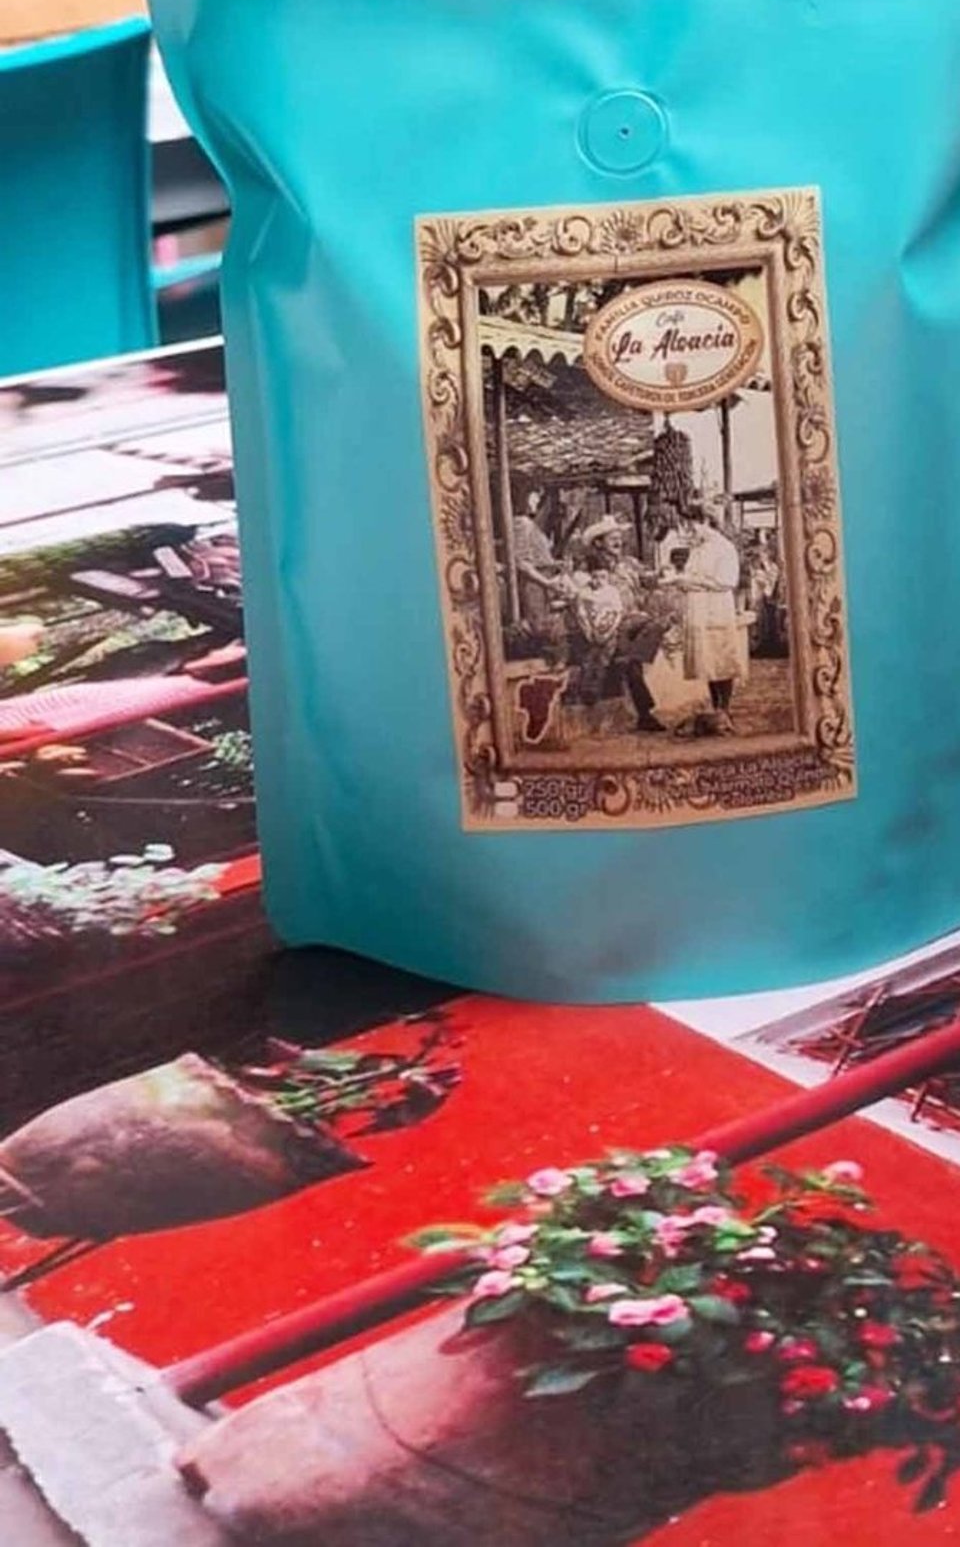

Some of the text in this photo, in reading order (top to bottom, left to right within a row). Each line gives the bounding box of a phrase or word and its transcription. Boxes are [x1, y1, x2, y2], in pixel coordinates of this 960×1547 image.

[611, 324, 735, 364] La Alsacia
[525, 800, 561, 817] 500
